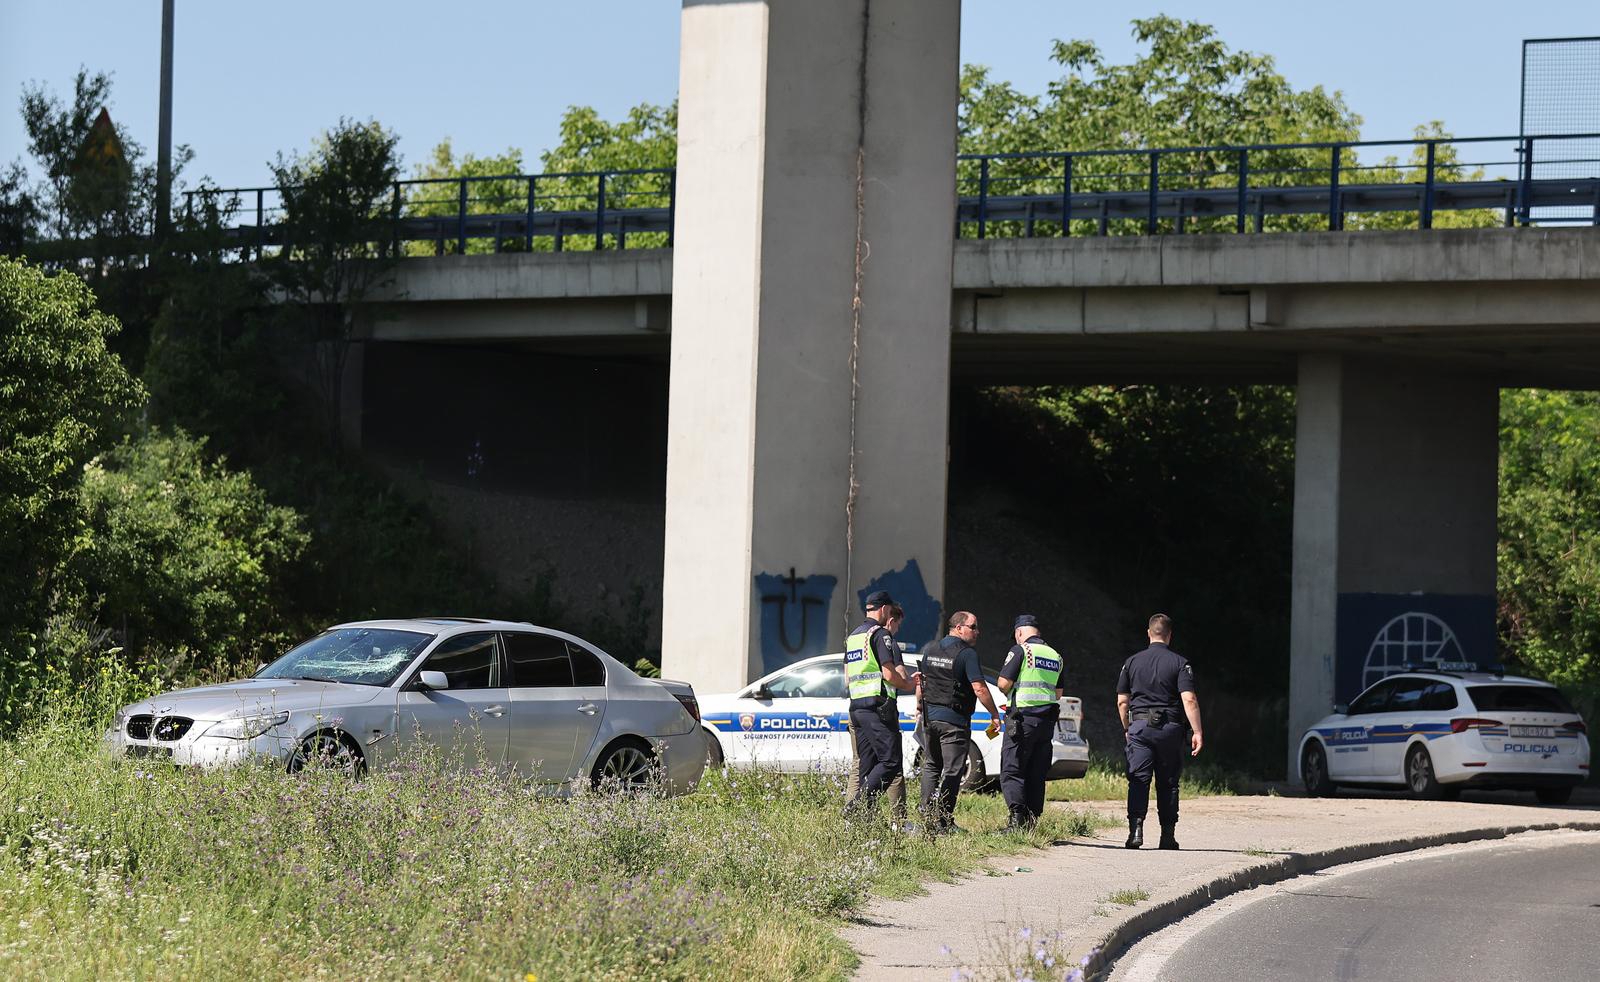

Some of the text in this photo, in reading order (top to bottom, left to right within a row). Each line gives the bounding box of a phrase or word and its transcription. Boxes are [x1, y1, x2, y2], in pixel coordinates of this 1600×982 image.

[847, 651, 862, 661] OLICIJA
[1036, 659, 1059, 669] POLICIJA
[760, 718, 831, 729] POLICIJA
[1342, 731, 1368, 740] POLICIJA
[1504, 743, 1559, 753] POLICIJA
